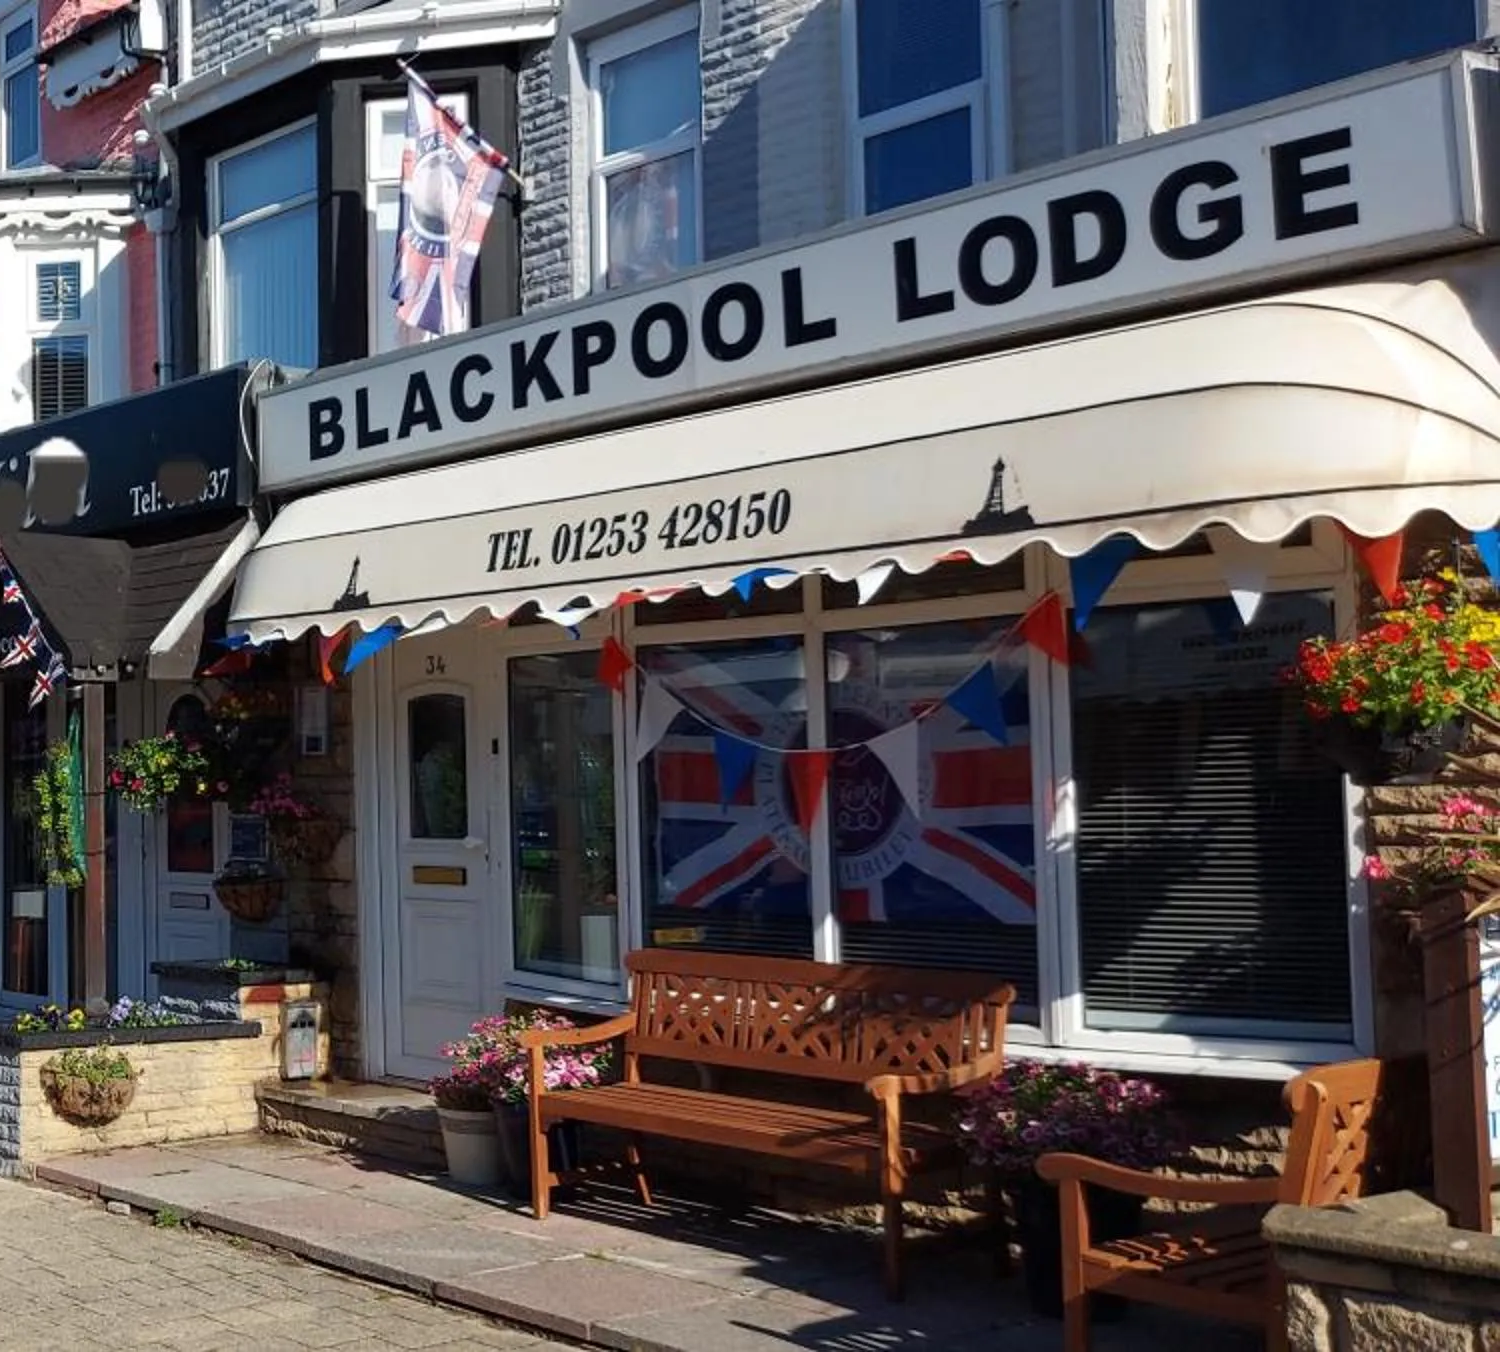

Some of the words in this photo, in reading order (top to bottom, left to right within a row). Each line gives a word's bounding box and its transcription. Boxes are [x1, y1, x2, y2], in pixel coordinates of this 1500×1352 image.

[307, 267, 838, 462] BLACKPOOL
[893, 126, 1360, 323] LODGE
[129, 480, 162, 517] Tel:
[487, 527, 541, 573] TEL.
[551, 510, 649, 566] 01253
[657, 488, 792, 551] 428150
[424, 653, 447, 676] 34
